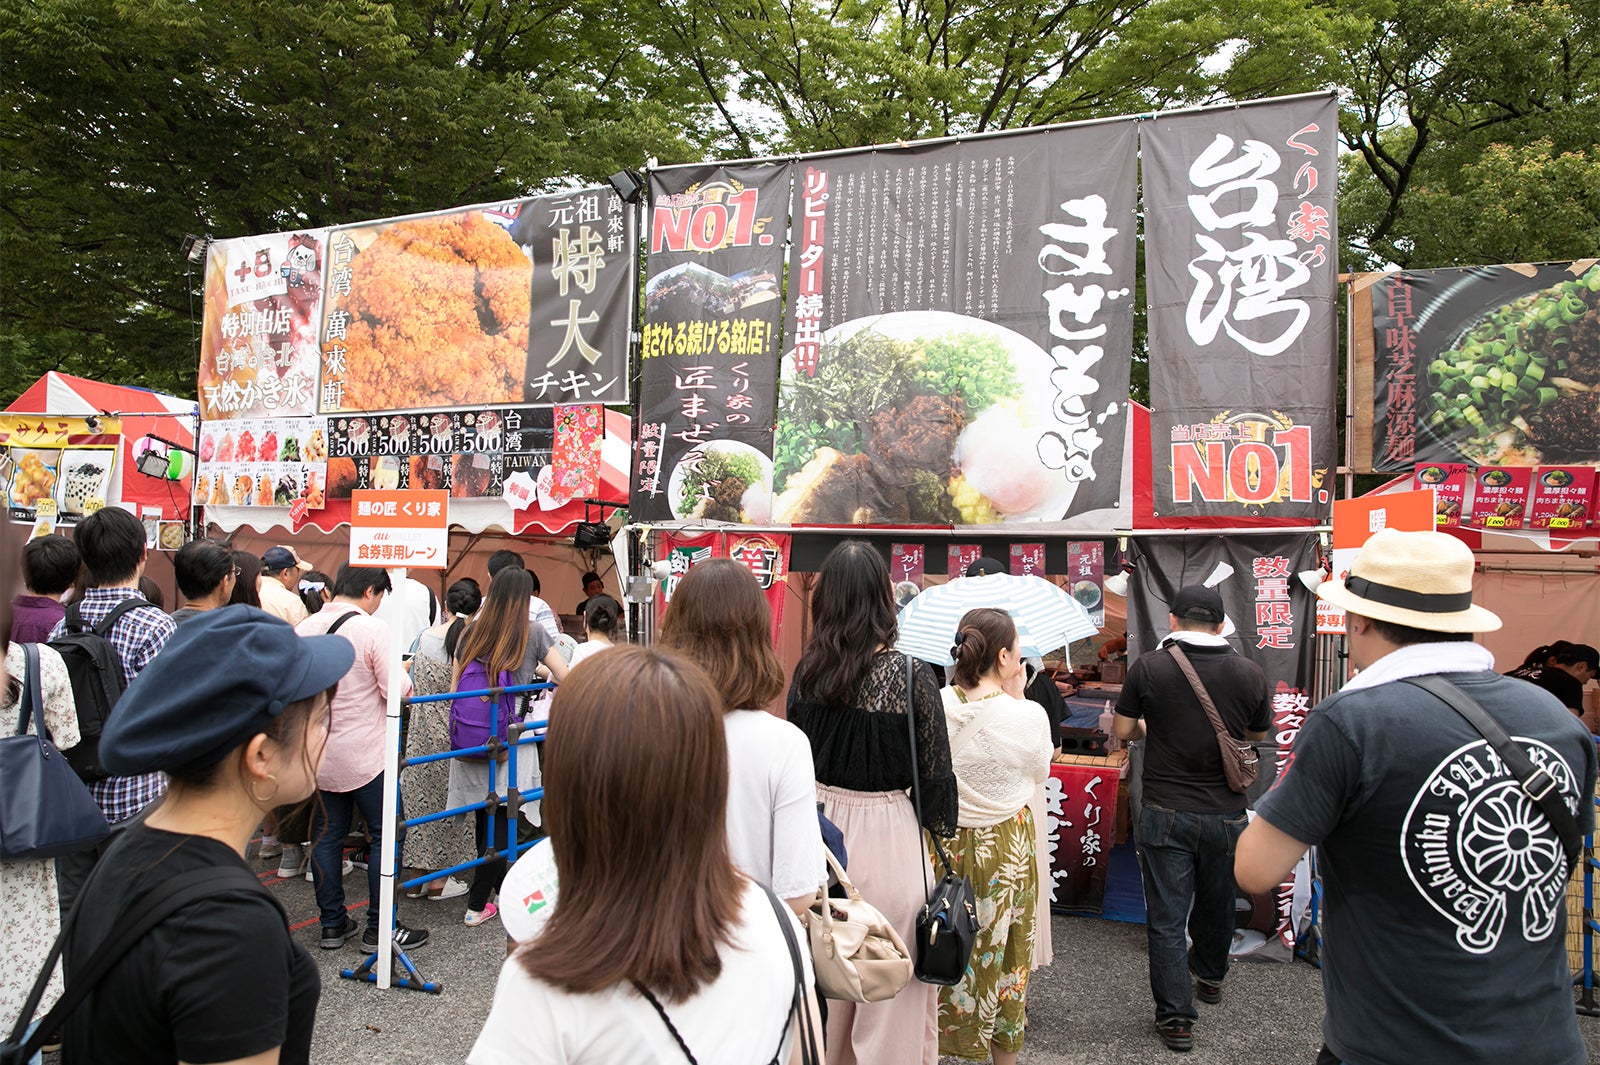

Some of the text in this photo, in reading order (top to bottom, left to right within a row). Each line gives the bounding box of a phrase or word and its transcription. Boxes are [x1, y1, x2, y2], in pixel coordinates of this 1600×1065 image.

[1285, 122, 1331, 269] くり家の
[547, 195, 603, 228] 元祖
[607, 194, 625, 253] 萬來軒
[1184, 132, 1311, 357] 台湾
[545, 225, 606, 369] 特大
[220, 305, 295, 340] 特別出店
[323, 232, 355, 411] 台湾 萬來軒
[1036, 193, 1130, 484] まぜそば
[214, 342, 296, 376] 台湾の台北
[202, 374, 311, 413] 天然かき氷
[530, 371, 619, 401] チキン
[725, 361, 753, 425] くり家の
[379, 436, 410, 455] 500
[419, 434, 453, 454] 500
[462, 432, 501, 453] 500
[504, 409, 523, 452] 台湾
[671, 365, 722, 501] 匠まぜそば
[1170, 423, 1252, 442] 当店売上
[336, 437, 370, 456] 500
[504, 455, 548, 467] TAIWAN
[637, 422, 664, 495] 数量限定
[358, 465, 369, 489] 特大
[400, 463, 410, 488] 特大
[443, 462, 453, 488] 特大
[490, 462, 502, 488] 特大
[357, 501, 441, 517] 麺の匠 くり家
[358, 544, 438, 560] 食券専用レーン
[373, 532, 390, 541] au
[901, 555, 915, 581] カレー
[1079, 554, 1093, 576] 元祖
[1252, 555, 1296, 650] 数量限定
[1080, 776, 1102, 867] くり家の
